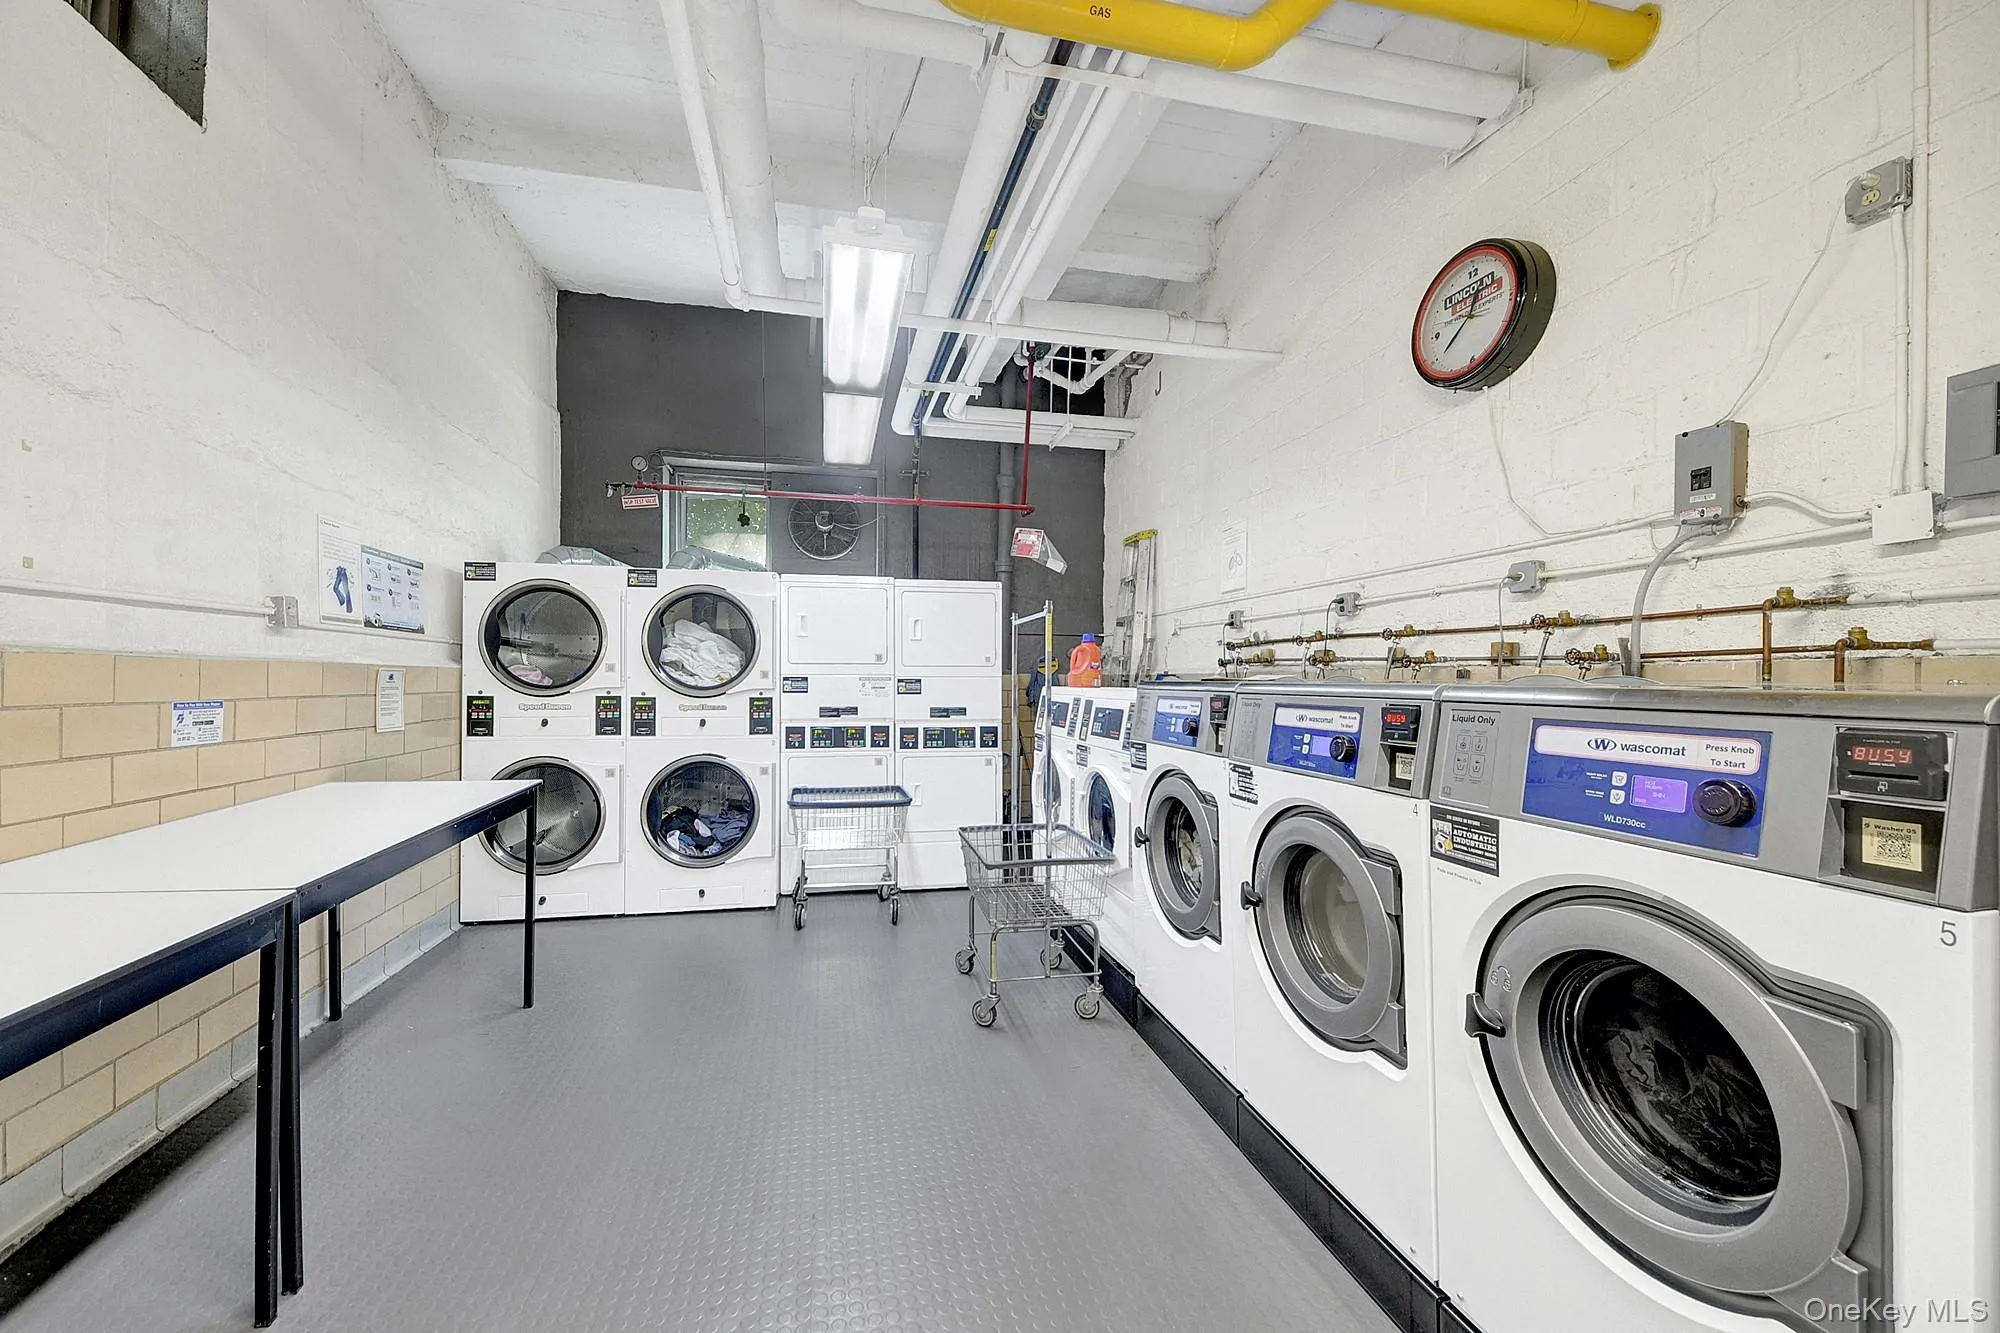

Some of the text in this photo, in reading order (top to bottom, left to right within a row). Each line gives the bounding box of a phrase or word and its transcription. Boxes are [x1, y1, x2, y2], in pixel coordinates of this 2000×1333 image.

[1089, 5, 1111, 19] GAS
[1468, 267, 1479, 280] 12
[1445, 273, 1494, 309] LINCOLN
[1456, 283, 1498, 311] ELETRIC
[1435, 331, 1441, 340] 9
[518, 703, 545, 711] Speed
[1452, 714, 1496, 726] Liquid Only
[1620, 742, 1686, 757] wascomat
[1705, 743, 1755, 754] Press Knob
[1854, 746, 1911, 763] BUSY
[1710, 758, 1746, 769] To Start
[1412, 803, 1419, 816] 4
[1603, 813, 1647, 829] WLD730cc
[1874, 824, 1904, 833] Washer
[1453, 828, 1497, 845] AUTOMATIC
[1453, 836, 1497, 853] INDUSTRIES
[1940, 920, 1957, 947] 5
